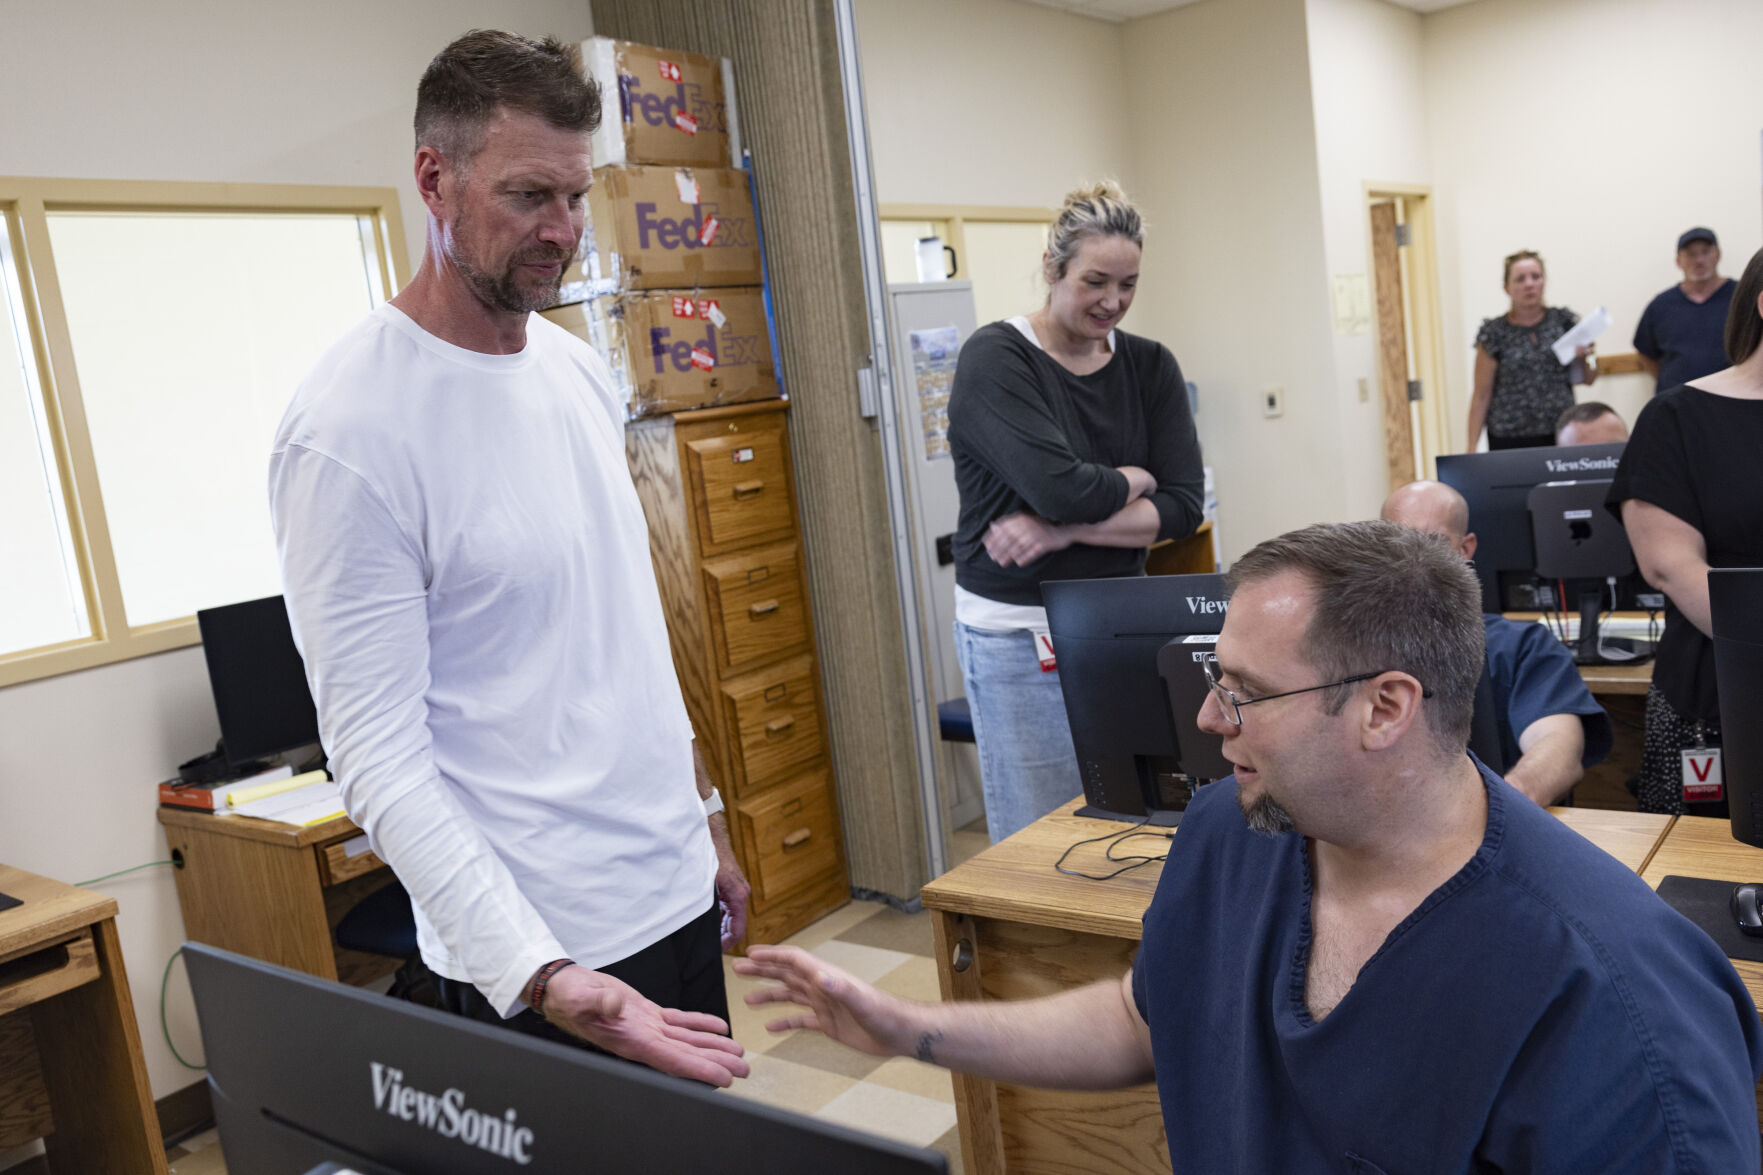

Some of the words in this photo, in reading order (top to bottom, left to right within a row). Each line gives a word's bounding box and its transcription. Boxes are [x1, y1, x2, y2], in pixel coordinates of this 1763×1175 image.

[635, 203, 749, 250] FedEx
[650, 323, 761, 374] FedEx
[1545, 456, 1620, 473] ViewSonic
[1185, 596, 1232, 615] View
[1688, 756, 1715, 783] V
[369, 1061, 534, 1165] ViewSonic
